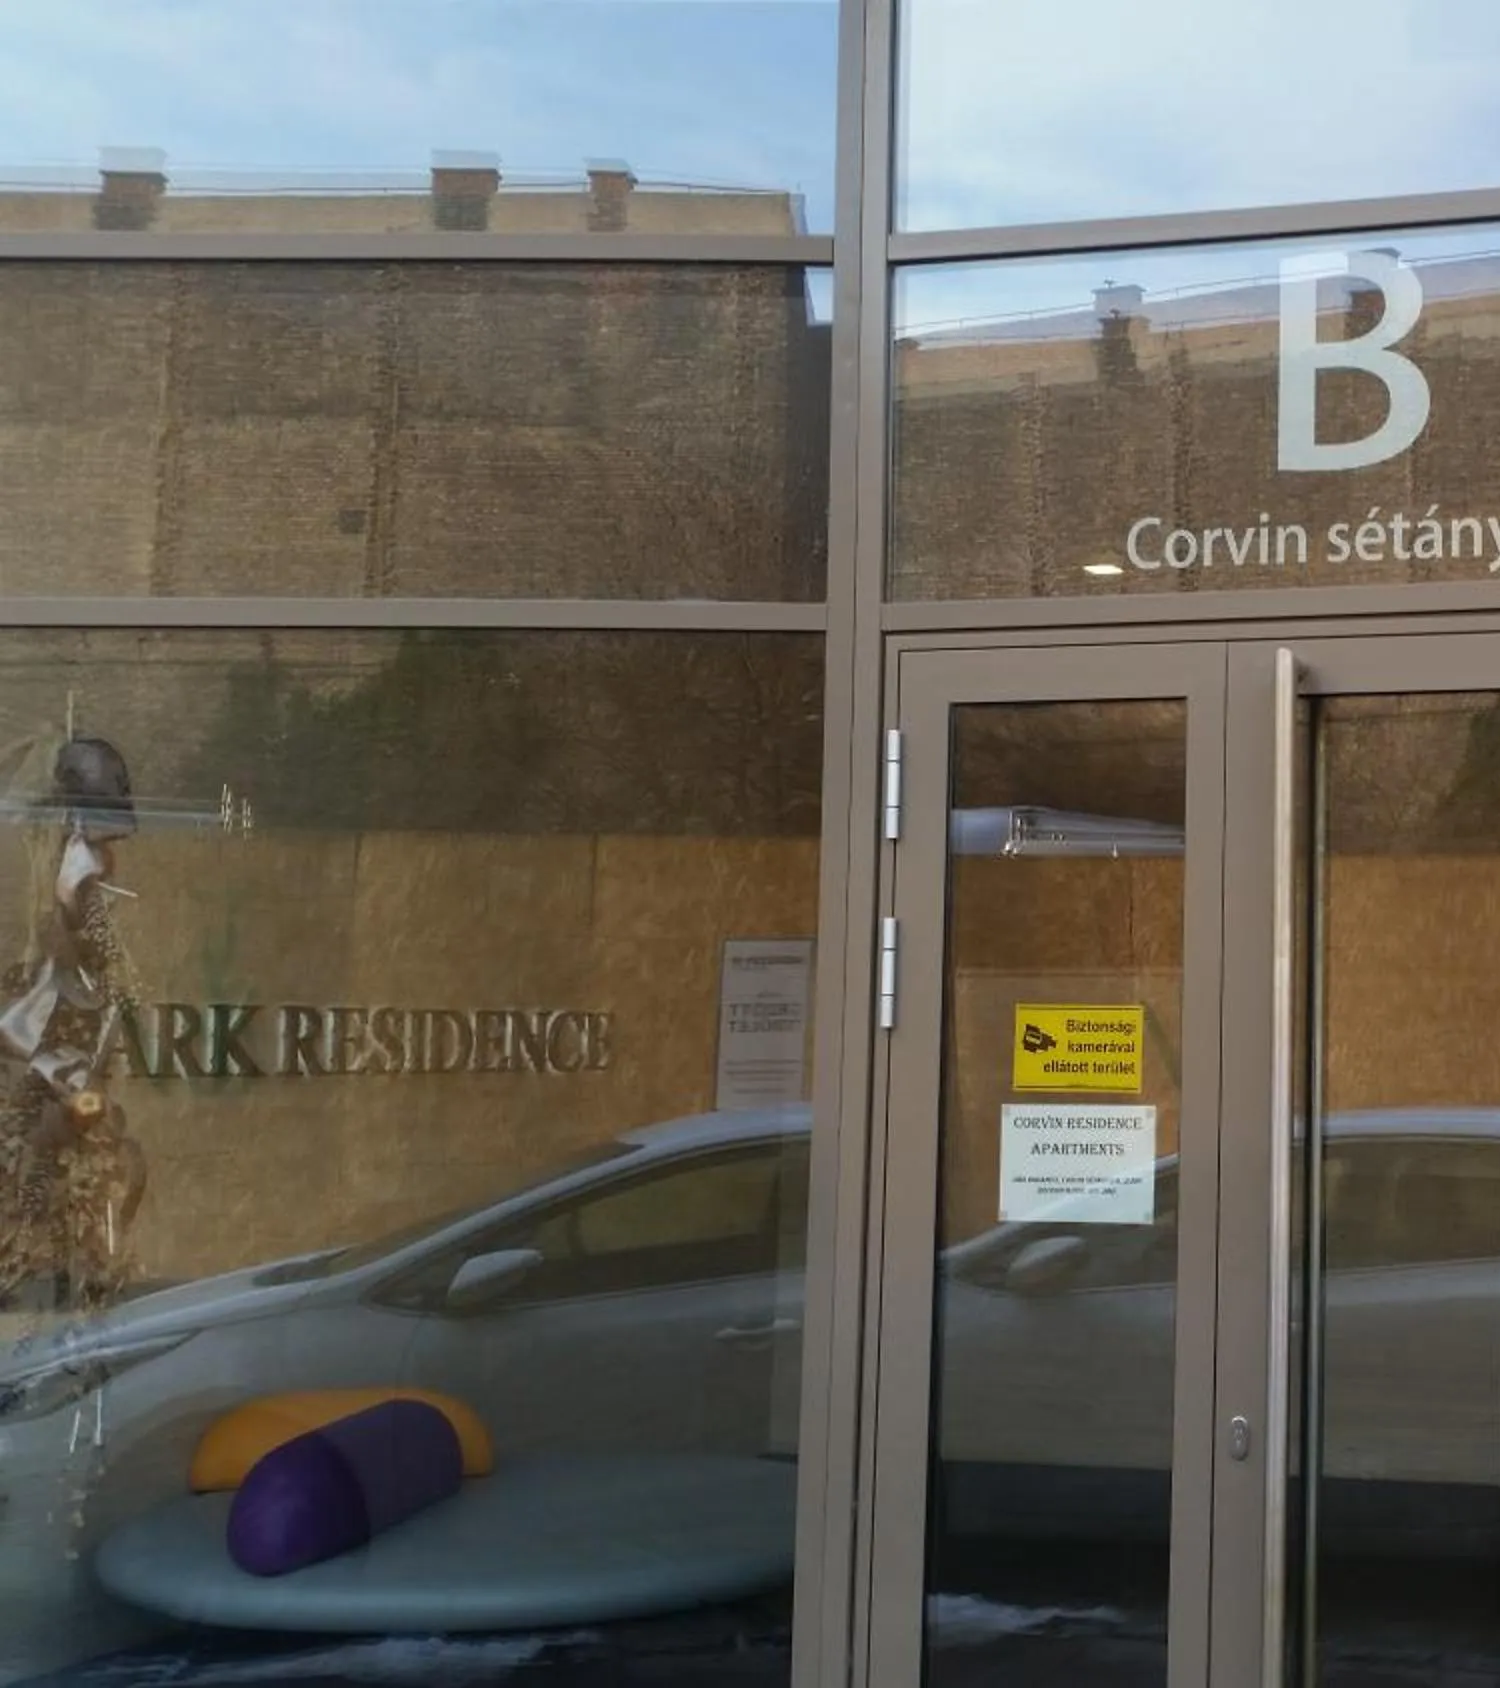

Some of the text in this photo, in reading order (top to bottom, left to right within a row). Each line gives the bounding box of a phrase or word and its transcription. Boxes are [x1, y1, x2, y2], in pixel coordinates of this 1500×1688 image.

[1278, 247, 1431, 472] B
[1126, 512, 1308, 571] Corvin
[1066, 1019, 1136, 1035] Biztonsági
[92, 1000, 616, 1078] ARK RESIDENCE
[1067, 1040, 1135, 1054] kamerával
[1043, 1059, 1136, 1075] ellátott terület
[1013, 1116, 1143, 1130] CORVIN RESIDENCE
[1030, 1143, 1125, 1156] APARTMENTS
